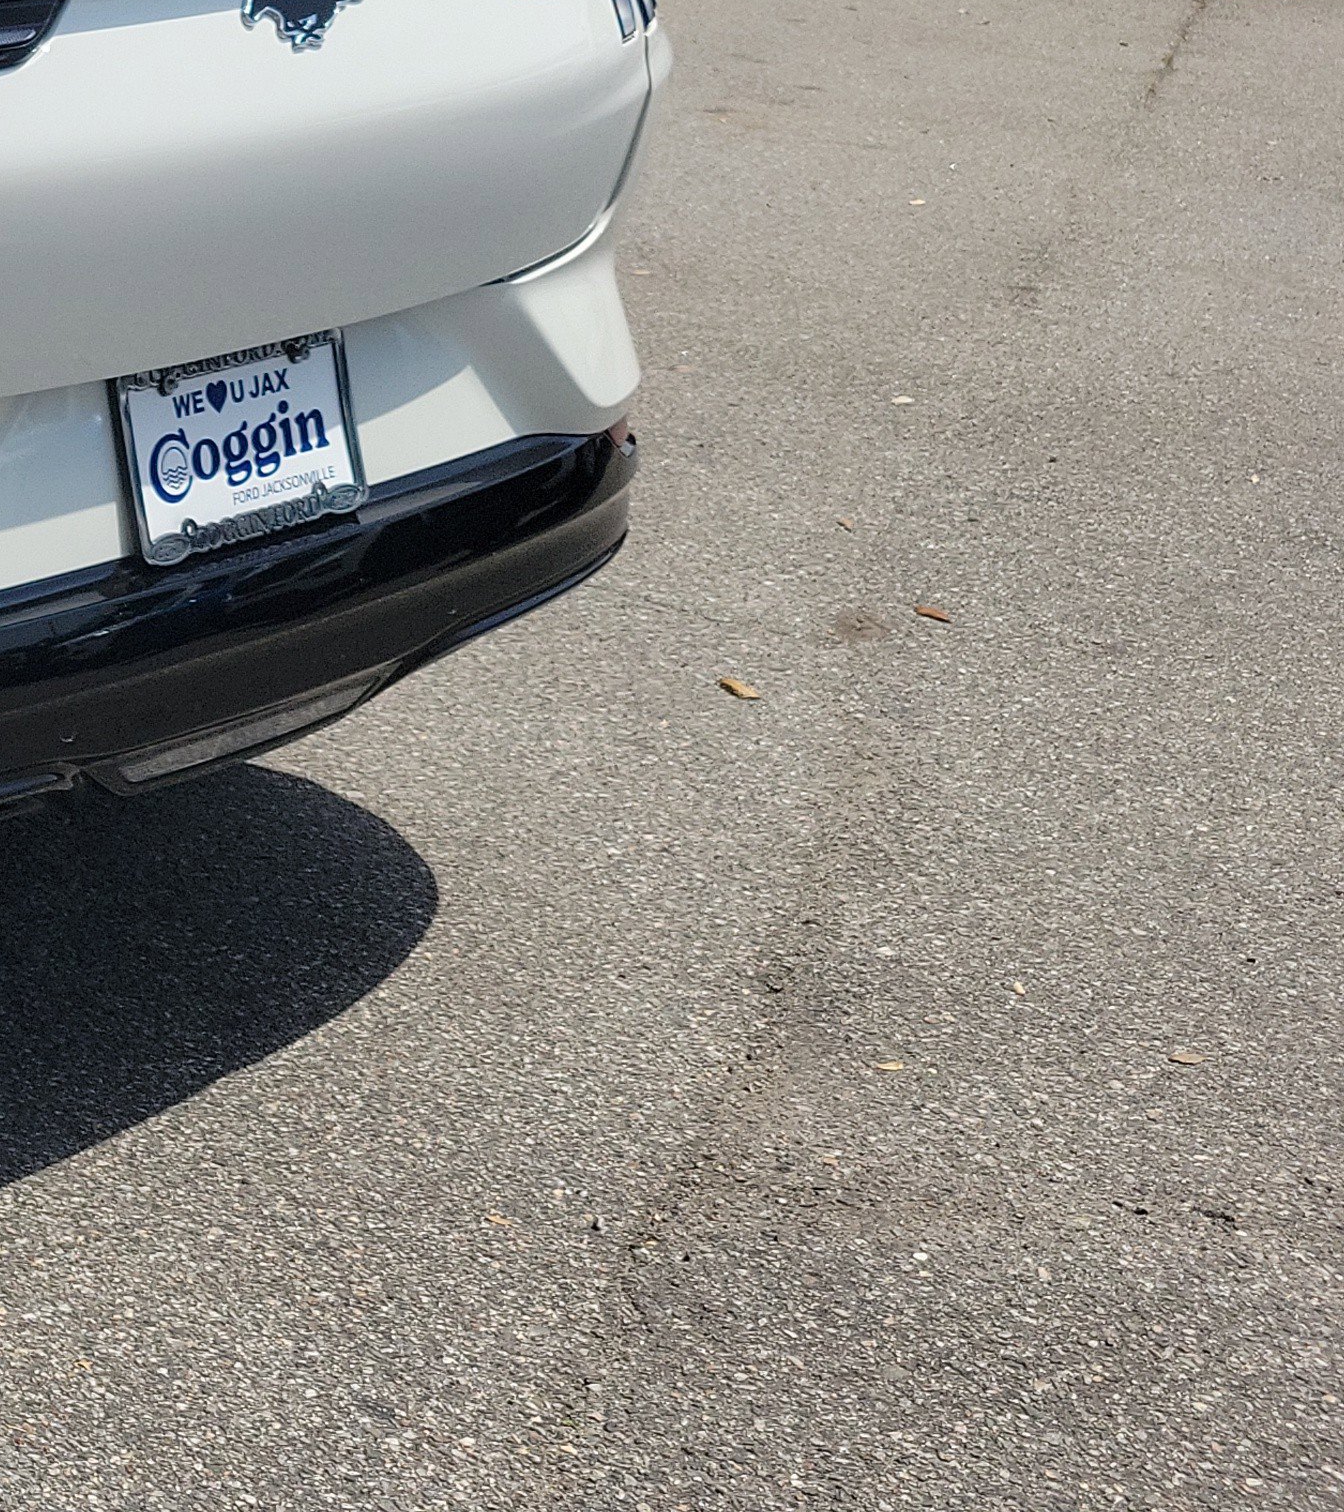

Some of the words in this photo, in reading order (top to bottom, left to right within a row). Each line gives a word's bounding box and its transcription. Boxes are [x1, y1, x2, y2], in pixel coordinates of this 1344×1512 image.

[172, 390, 206, 419] WE
[229, 378, 245, 403] U
[249, 368, 290, 400] JAX
[149, 399, 330, 504] Coggin
[232, 488, 260, 506] FORD
[261, 465, 337, 499] JACKSONVILLE
